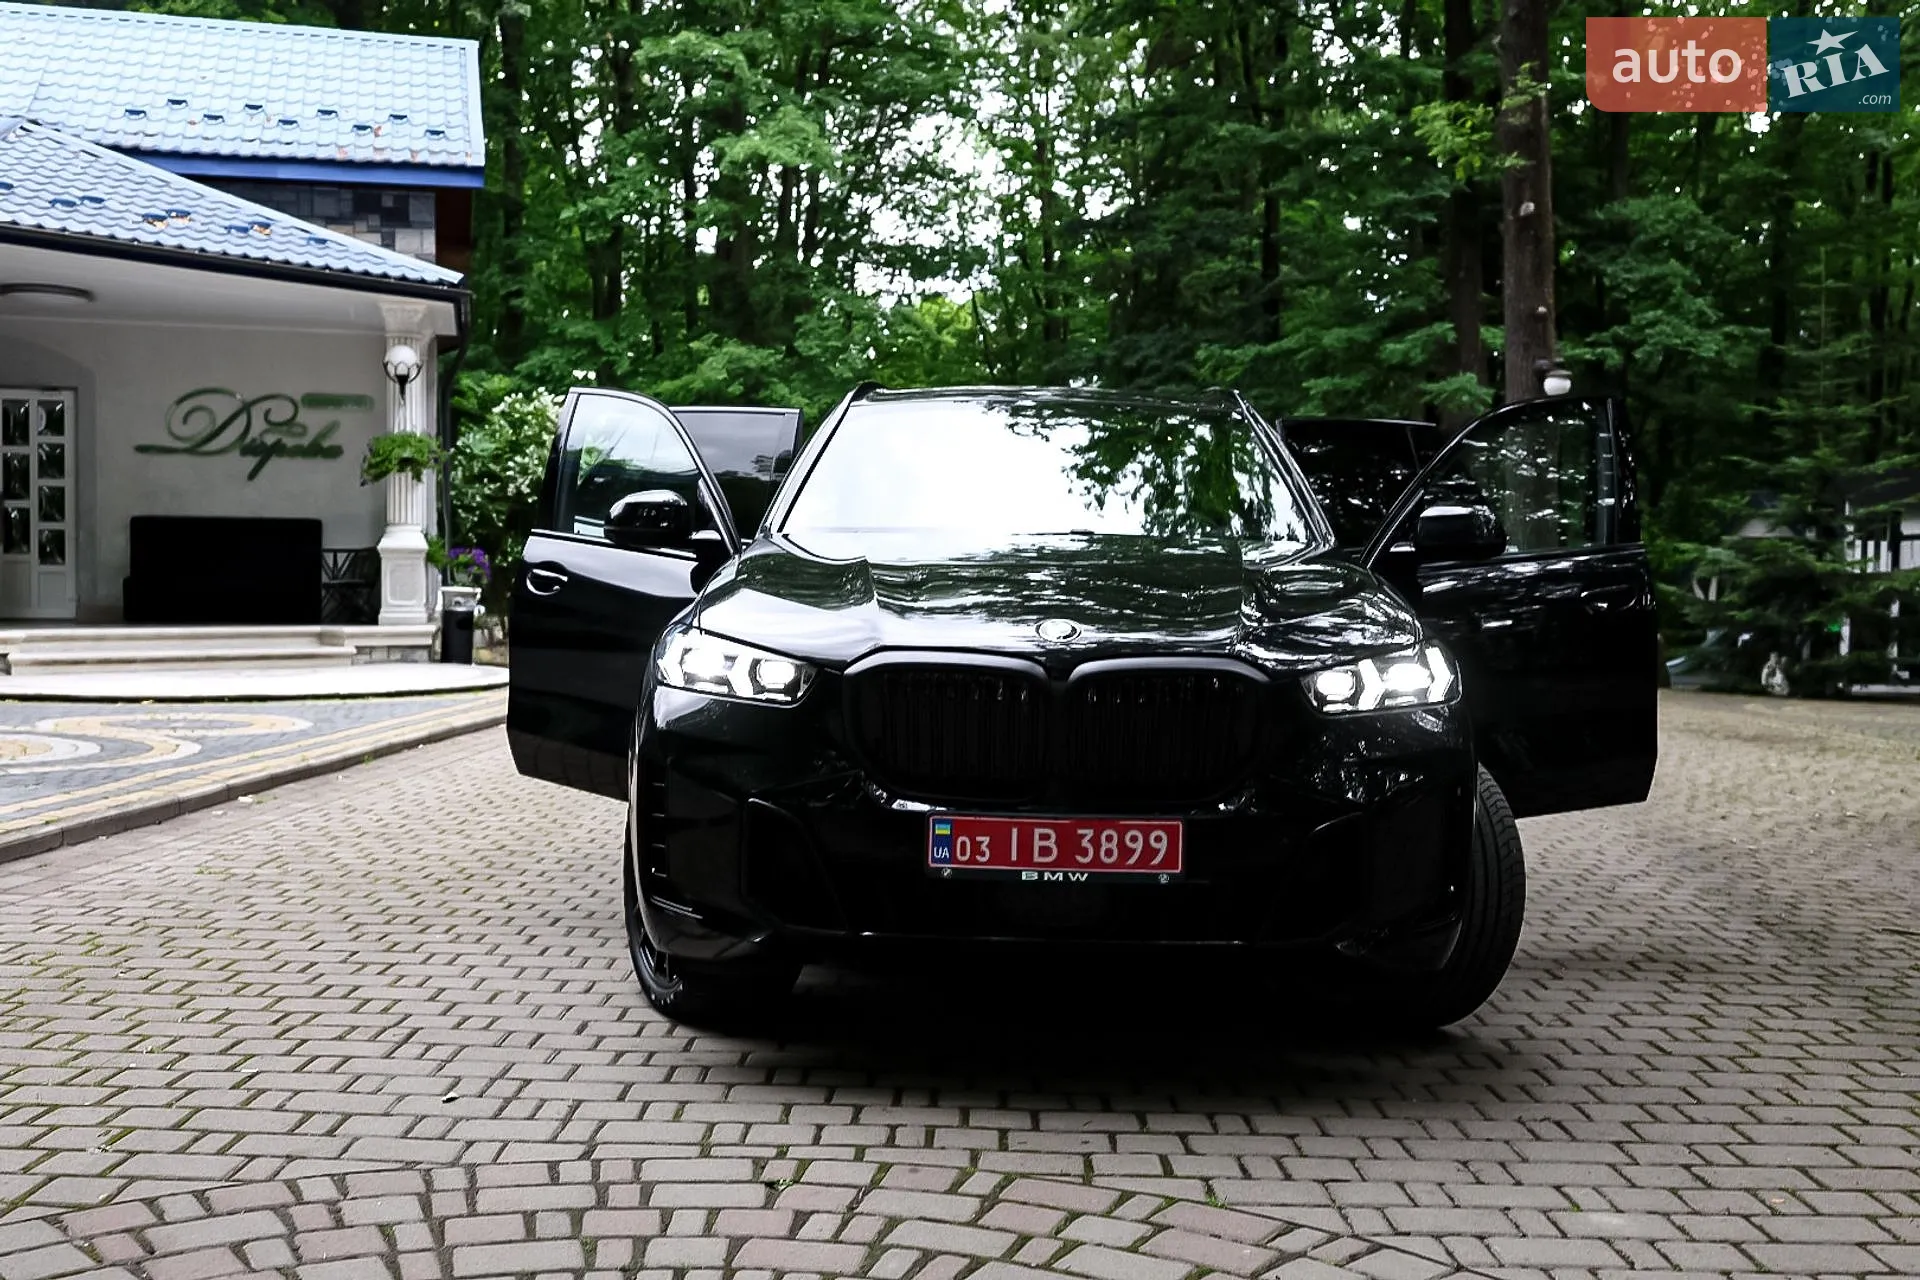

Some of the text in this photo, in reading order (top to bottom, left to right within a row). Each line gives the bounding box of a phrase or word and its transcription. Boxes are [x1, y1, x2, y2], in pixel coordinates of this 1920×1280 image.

[933, 846, 950, 859] UA
[955, 827, 1168, 866] 03 IB 3899
[1021, 870, 1089, 882] BMW
